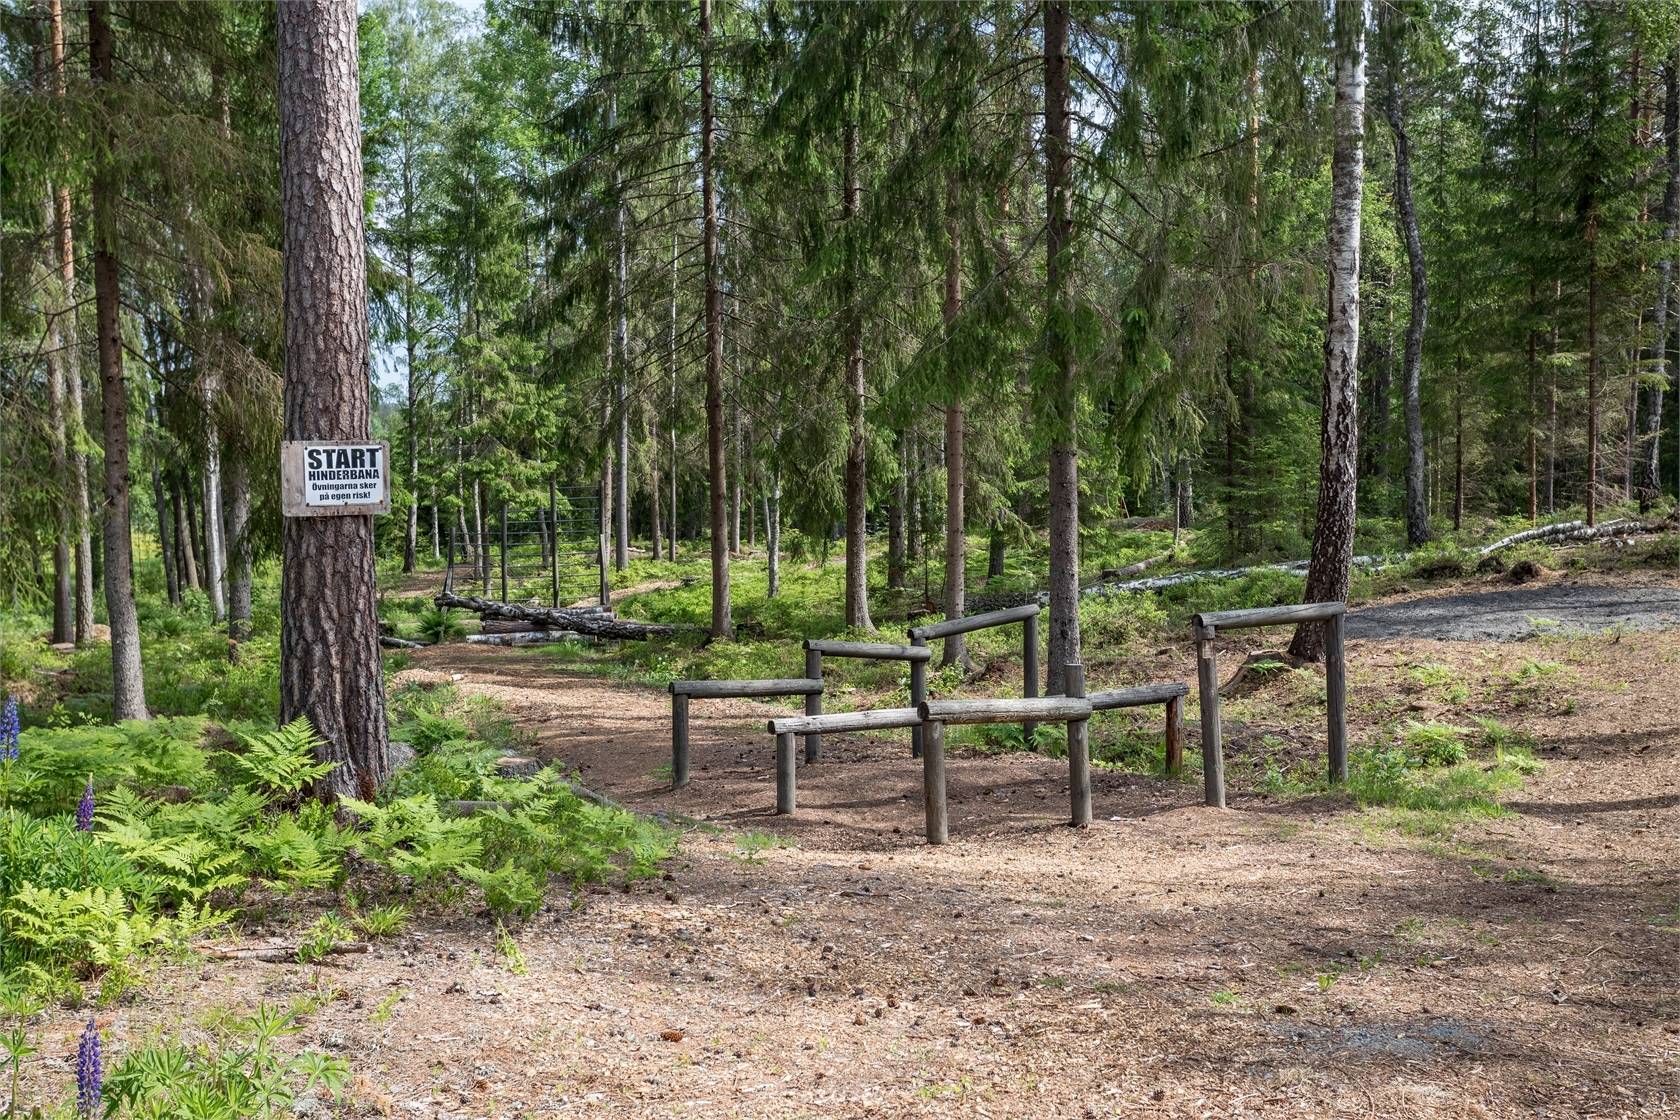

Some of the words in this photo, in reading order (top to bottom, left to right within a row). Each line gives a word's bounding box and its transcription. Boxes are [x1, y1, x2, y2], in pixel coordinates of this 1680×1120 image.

[308, 448, 379, 469] START
[308, 469, 380, 481] HINDERBANA
[312, 483, 358, 491] Övningarna
[319, 493, 330, 501] på
